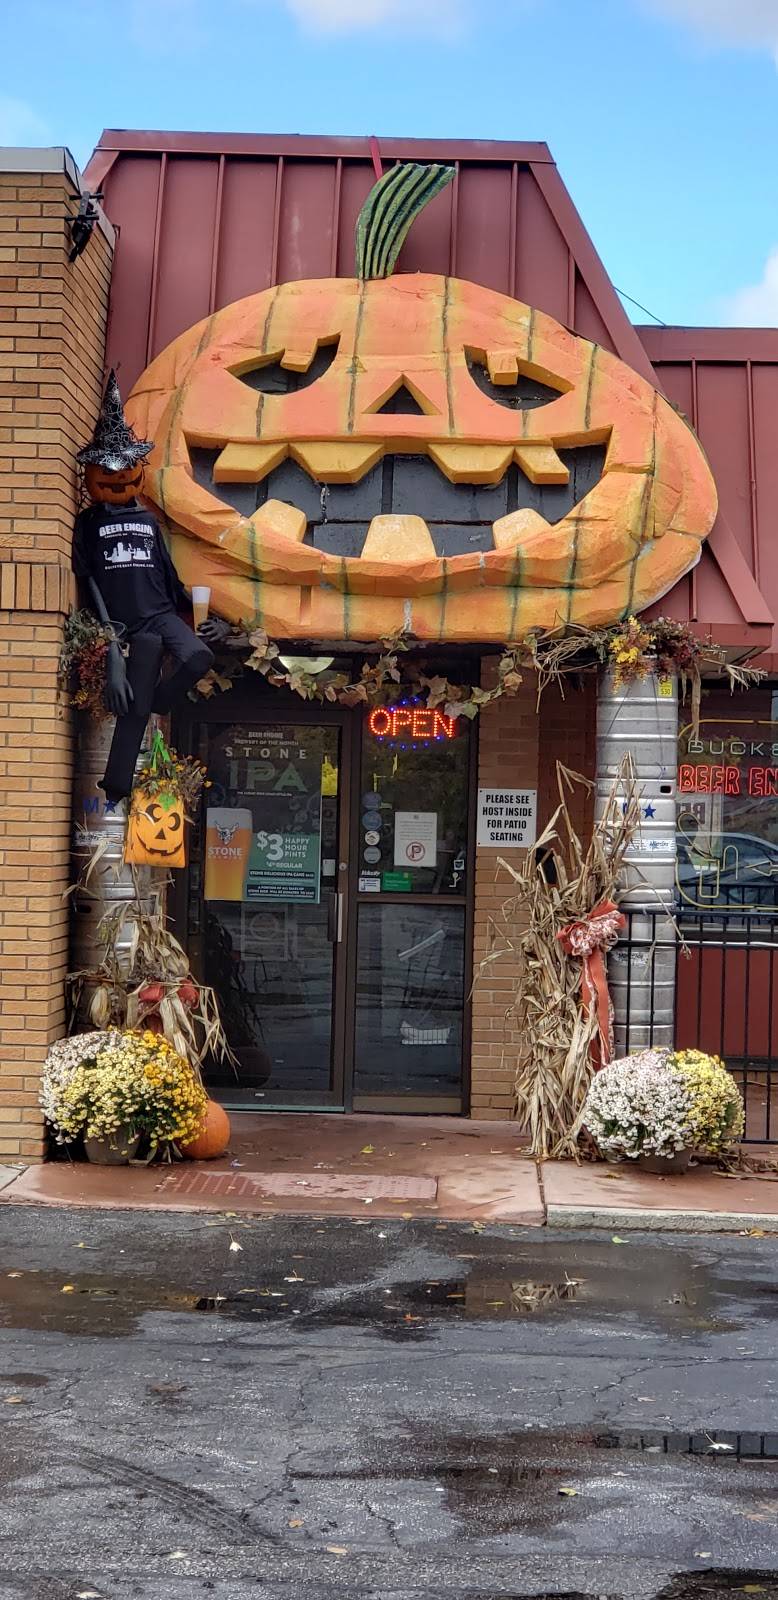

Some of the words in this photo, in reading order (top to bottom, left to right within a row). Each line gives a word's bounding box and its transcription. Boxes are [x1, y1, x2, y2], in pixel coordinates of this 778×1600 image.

[99, 523, 123, 537] BEER
[369, 708, 455, 738] OPEN
[225, 746, 307, 760] STONE
[228, 760, 309, 792] IPA
[679, 764, 740, 794] BEER
[485, 794, 514, 804] PLEASE
[515, 795, 530, 804] SEE
[482, 806, 504, 816] HOST
[505, 807, 532, 817] INSIDE
[487, 819, 502, 829] FOR
[504, 820, 527, 829] PATIO
[490, 832, 523, 842] SEATING
[207, 847, 244, 856] STONE
[257, 830, 284, 861] $3
